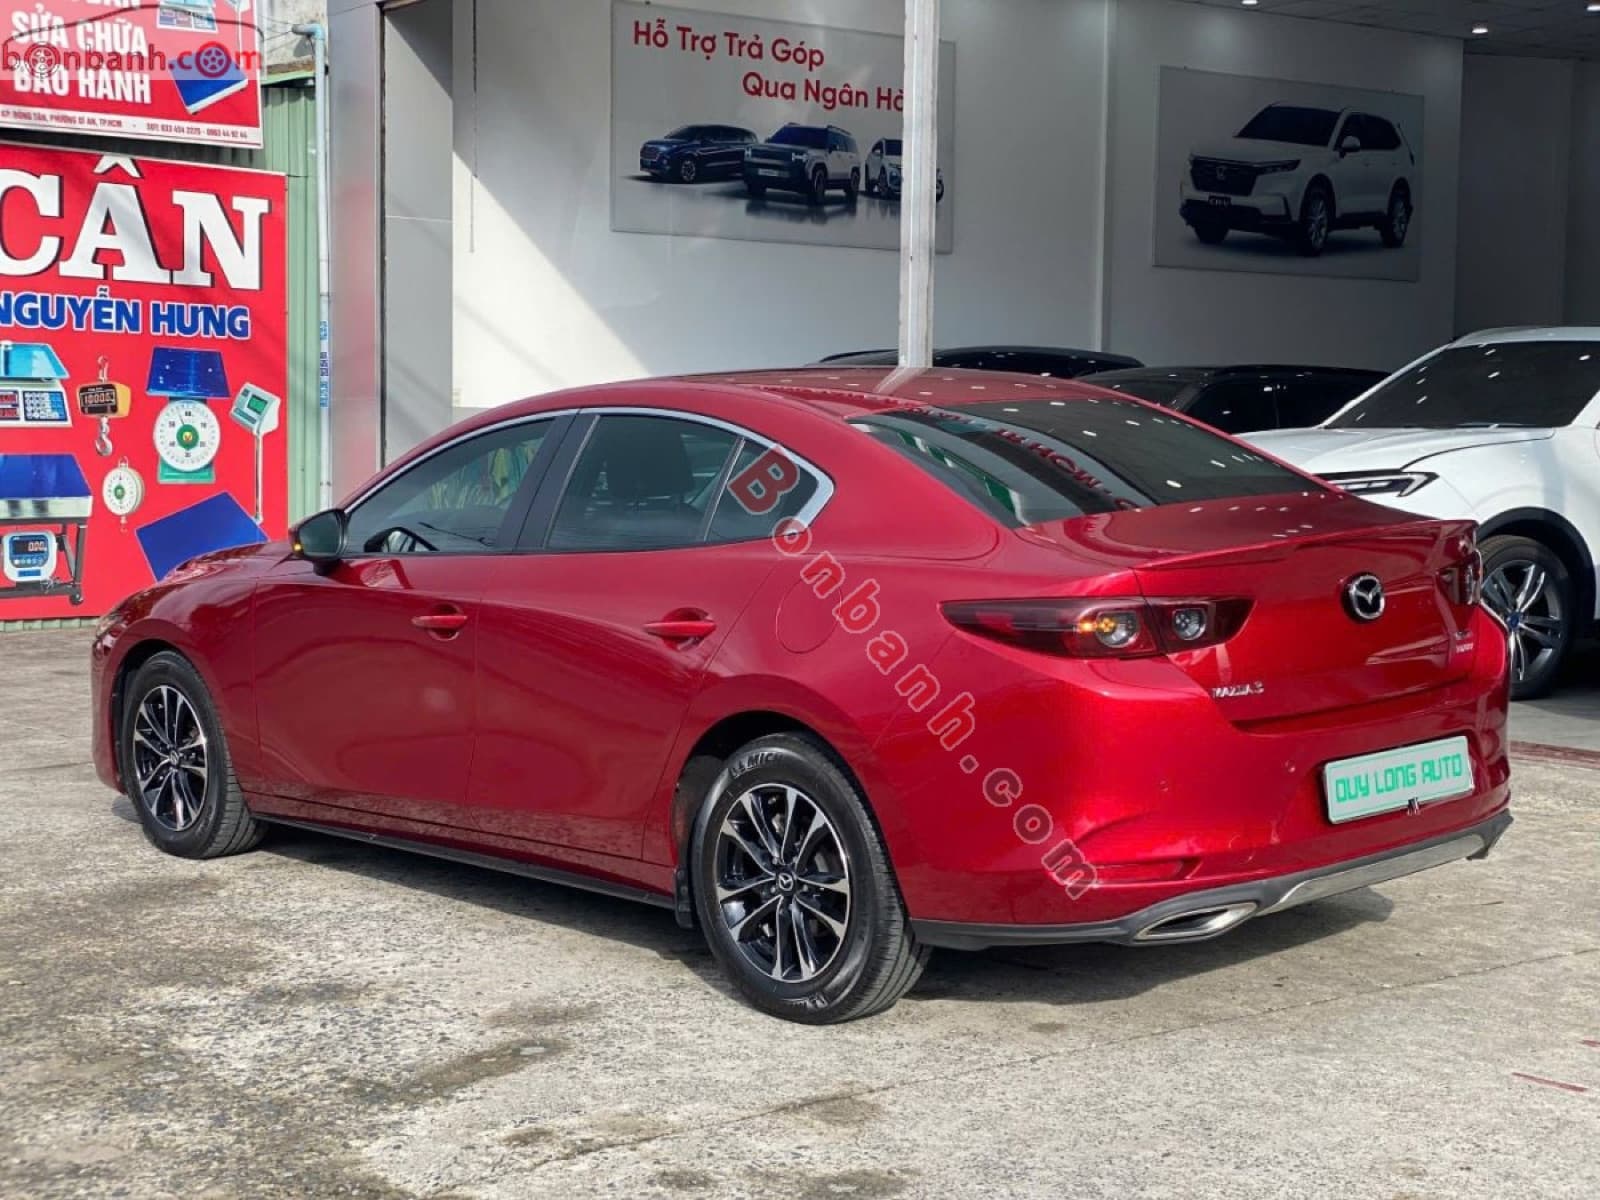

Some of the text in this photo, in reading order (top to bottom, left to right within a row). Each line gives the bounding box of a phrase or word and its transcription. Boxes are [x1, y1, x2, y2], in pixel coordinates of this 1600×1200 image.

[633, 18, 824, 71] Hỗ Trợ Trả Góp
[743, 71, 904, 112] Qua Ngân Hà
[0, 155, 269, 290] CÂN
[1374, 764, 1416, 794] LONG
[1421, 753, 1463, 784] AUTO
